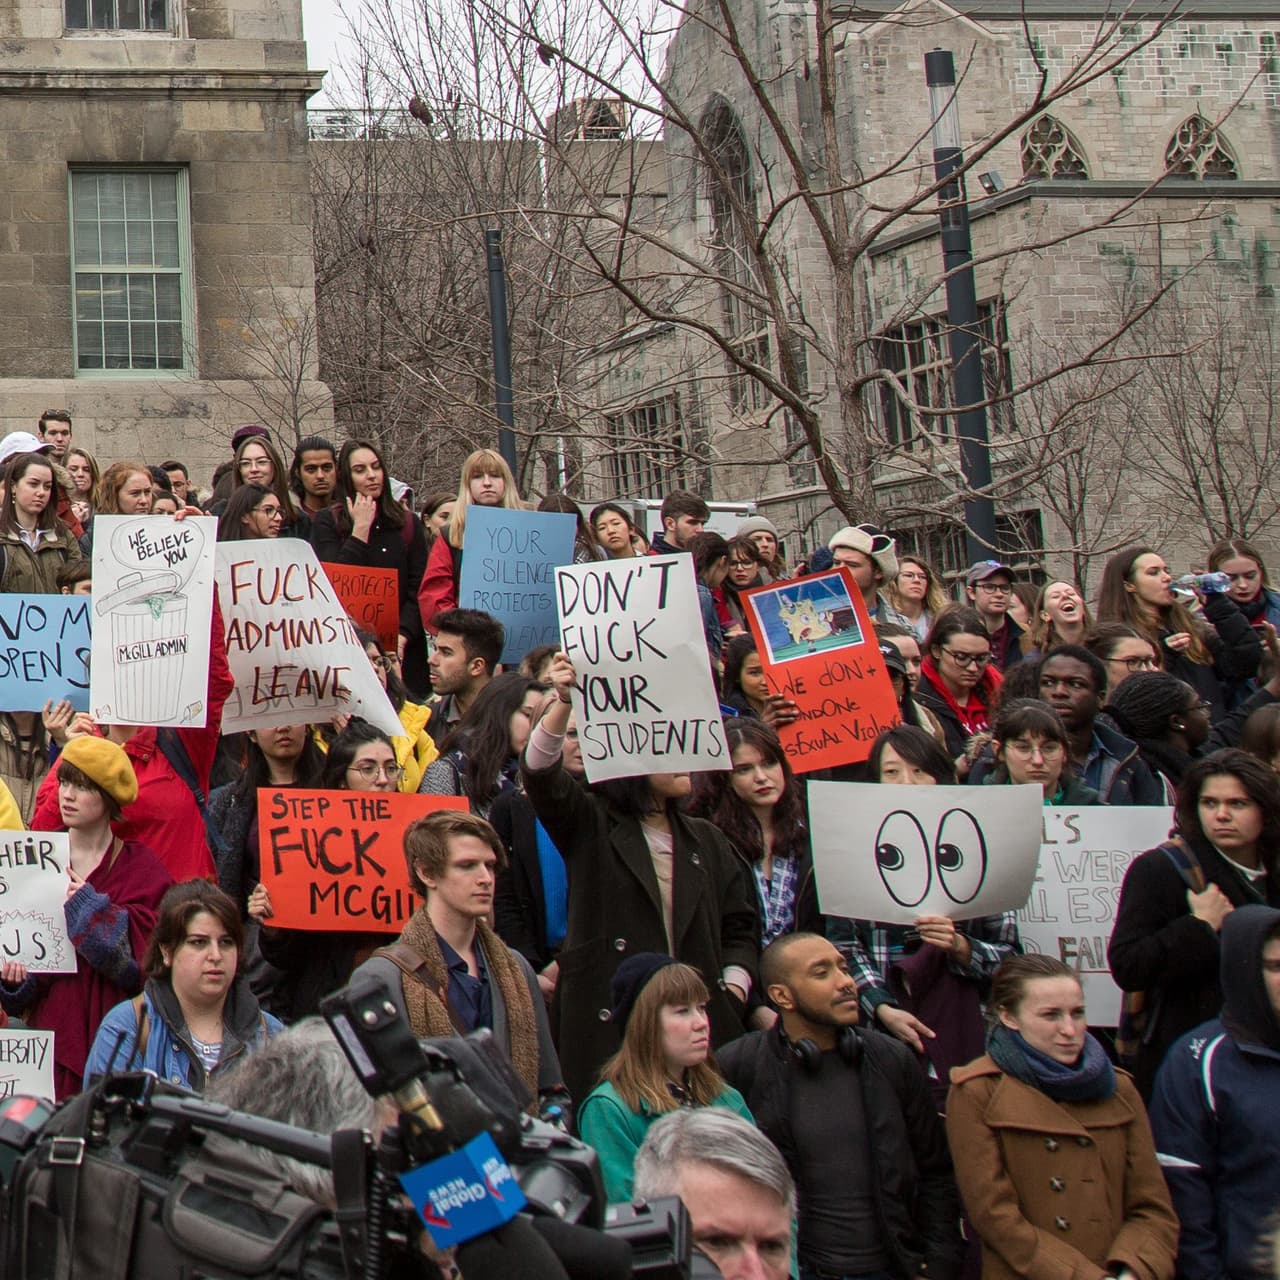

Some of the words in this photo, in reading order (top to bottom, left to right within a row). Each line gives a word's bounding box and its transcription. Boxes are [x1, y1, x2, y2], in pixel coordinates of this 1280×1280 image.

[128, 528, 148, 550] WE
[136, 529, 194, 562] BELIEVE
[486, 526, 547, 556] YOUR
[163, 547, 188, 568] YOU
[482, 558, 555, 585] SILENCE
[230, 560, 330, 605] FUCK
[558, 561, 679, 618] DON'T
[362, 603, 385, 626] OF
[473, 590, 553, 612] PROTECTS
[155, 636, 188, 659] ADMIN
[562, 618, 668, 665] FUCK
[573, 673, 663, 721] YOUR
[272, 792, 331, 820] STEP
[343, 798, 392, 822] THE
[270, 826, 386, 878] FUCK
[434, 1182, 487, 1217] Global
